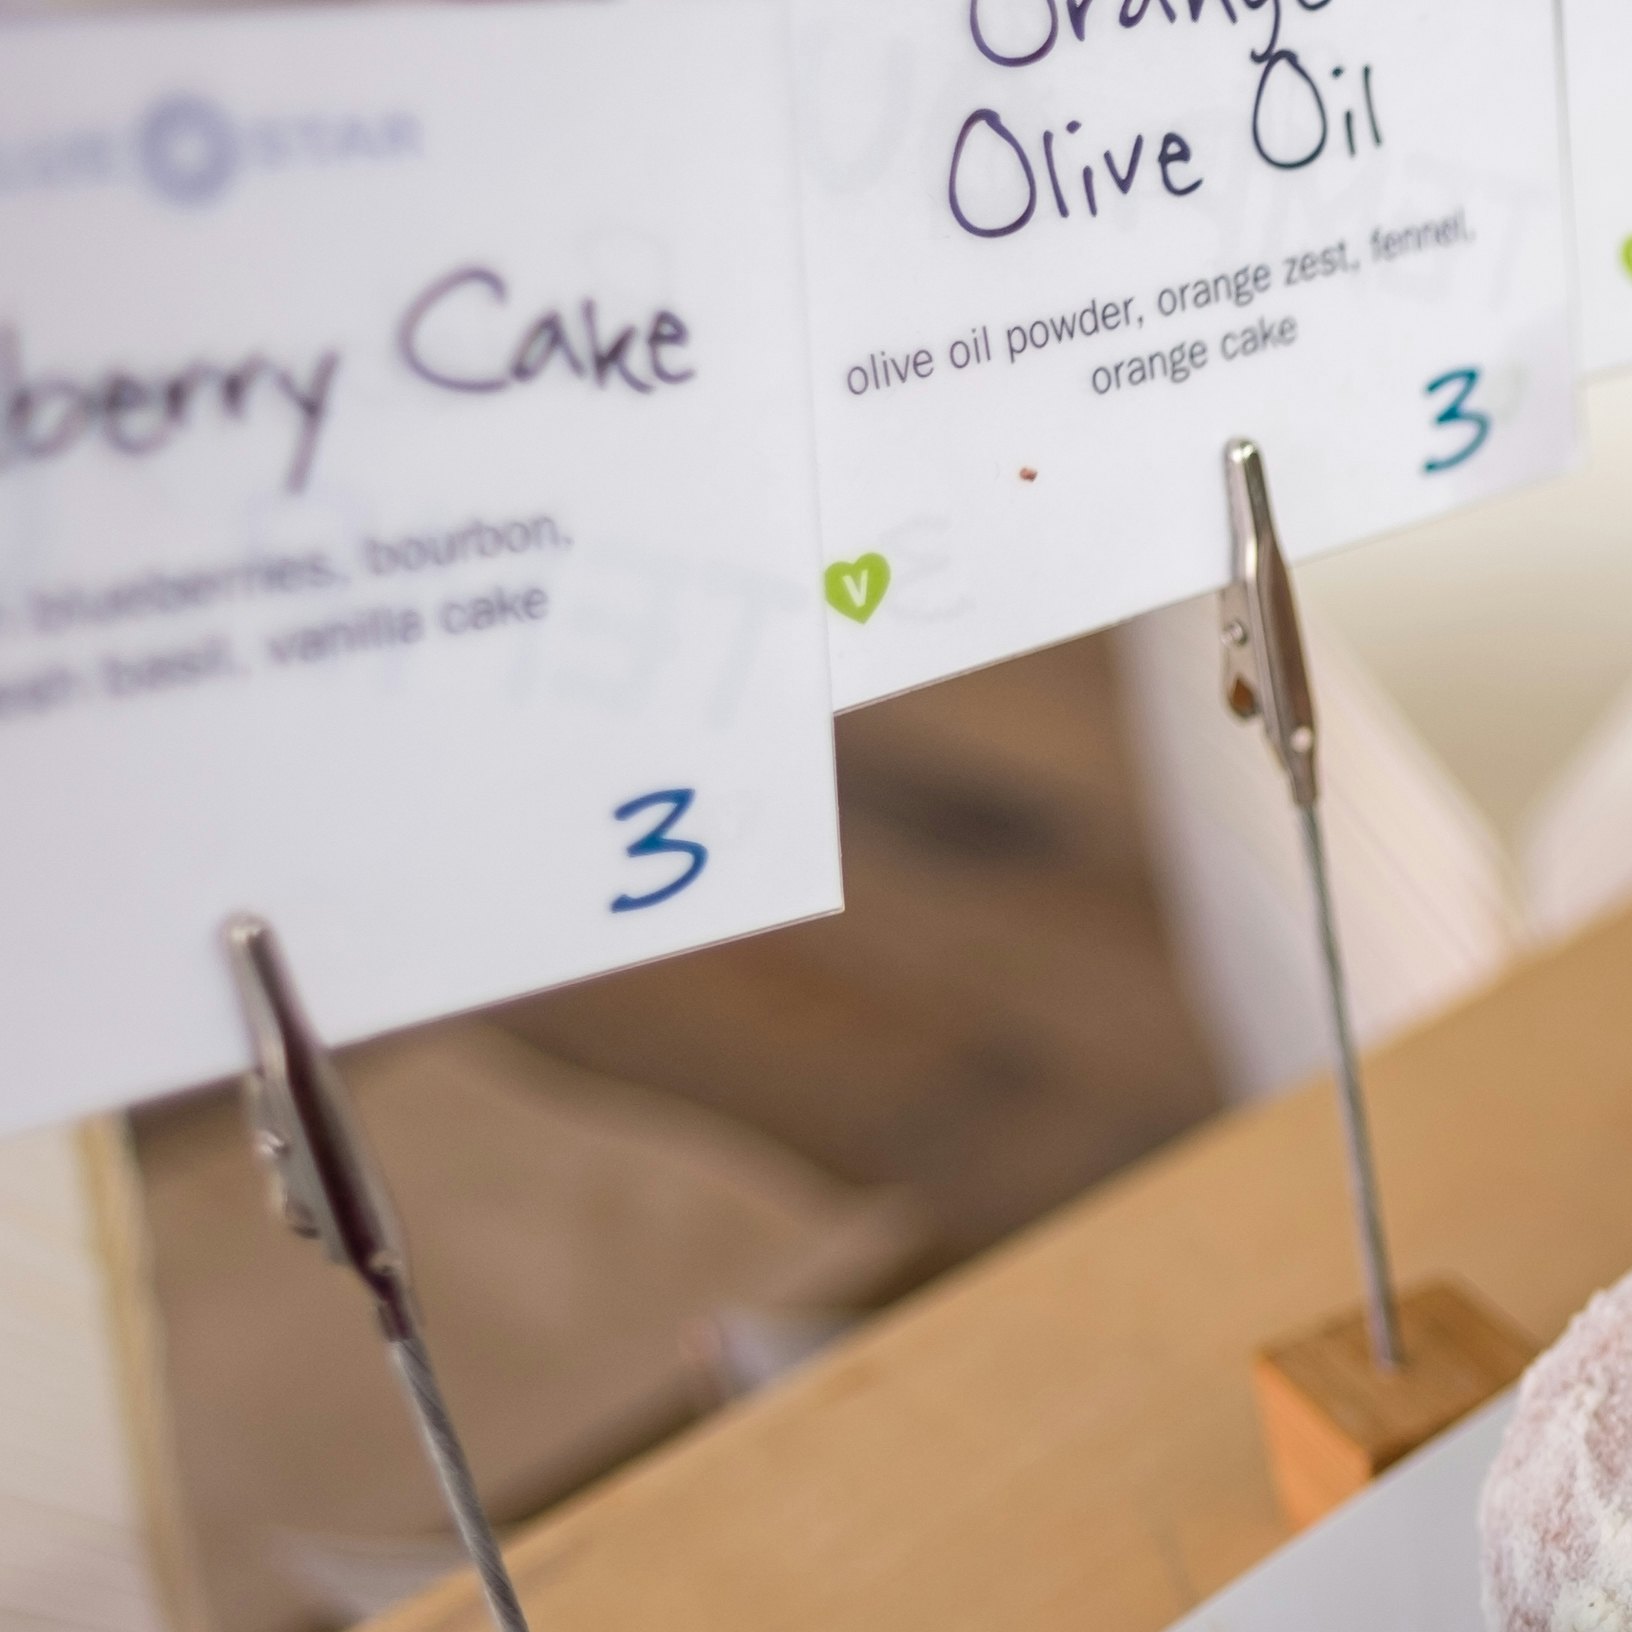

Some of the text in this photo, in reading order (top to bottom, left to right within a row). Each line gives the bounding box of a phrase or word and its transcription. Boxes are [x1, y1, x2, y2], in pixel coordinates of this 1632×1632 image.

[969, 0, 1331, 67] Orang
[949, 50, 1382, 238] Olive Oil
[401, 266, 696, 393] Cake
[846, 206, 1476, 395] olive oil powder, orange zest, fennel,
[1092, 316, 1298, 395] orange cake
[1424, 367, 1491, 474] 3
[268, 606, 424, 665] vanilla
[439, 583, 550, 636] cake
[609, 788, 708, 914] 3
